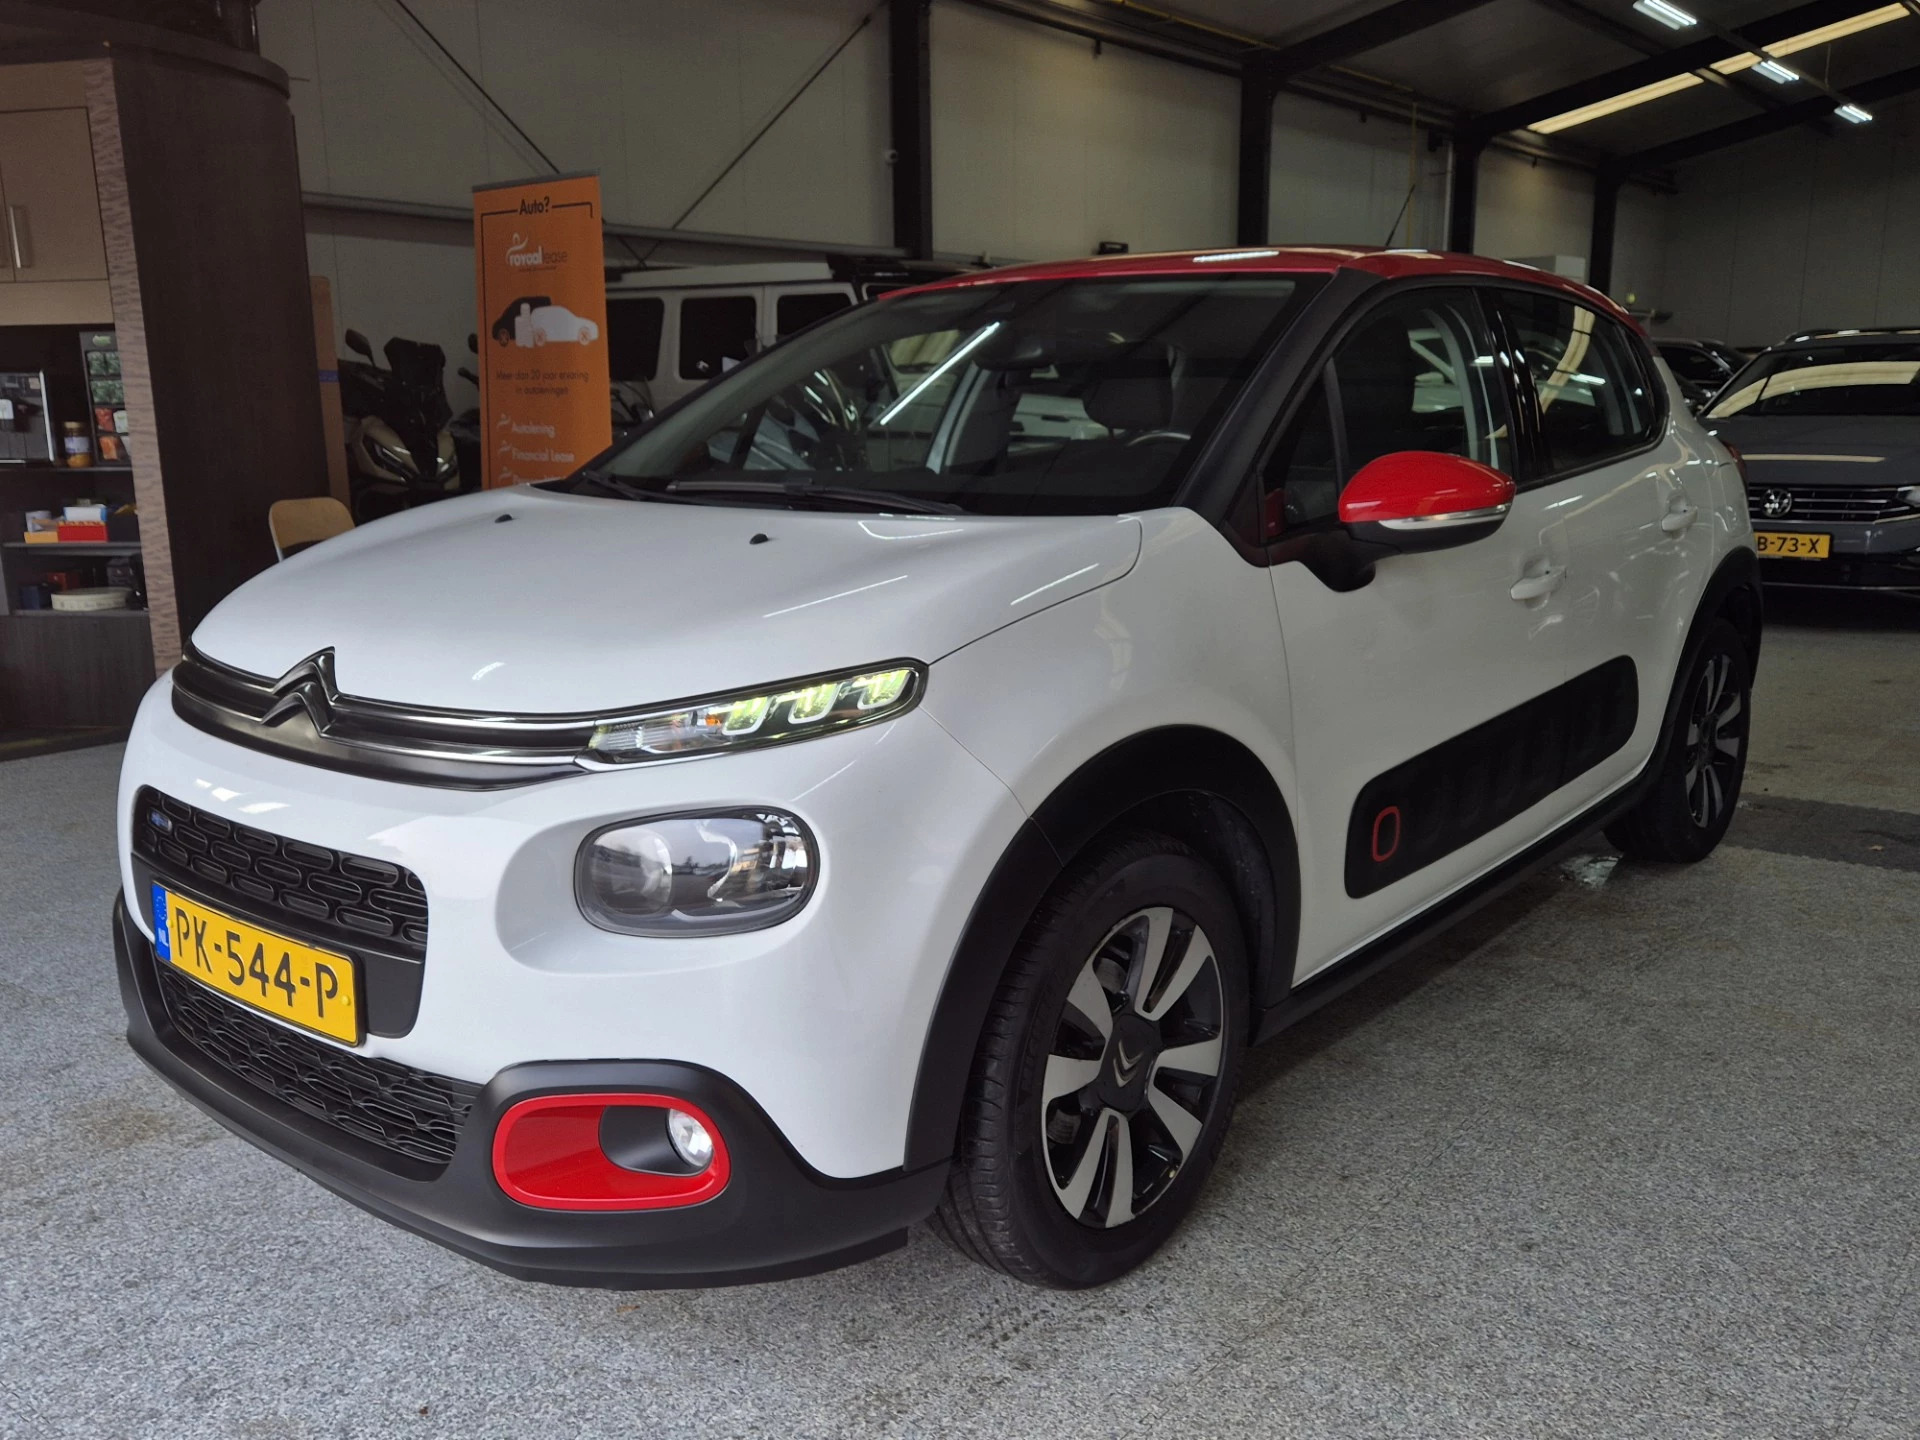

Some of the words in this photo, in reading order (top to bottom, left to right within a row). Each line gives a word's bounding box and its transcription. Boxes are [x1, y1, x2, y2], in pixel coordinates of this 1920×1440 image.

[520, 196, 550, 215] Auto?
[511, 446, 550, 461] Financial
[551, 448, 575, 462] Lease
[1757, 536, 1820, 554] B-73-X
[175, 906, 338, 1018] PK-544-P
